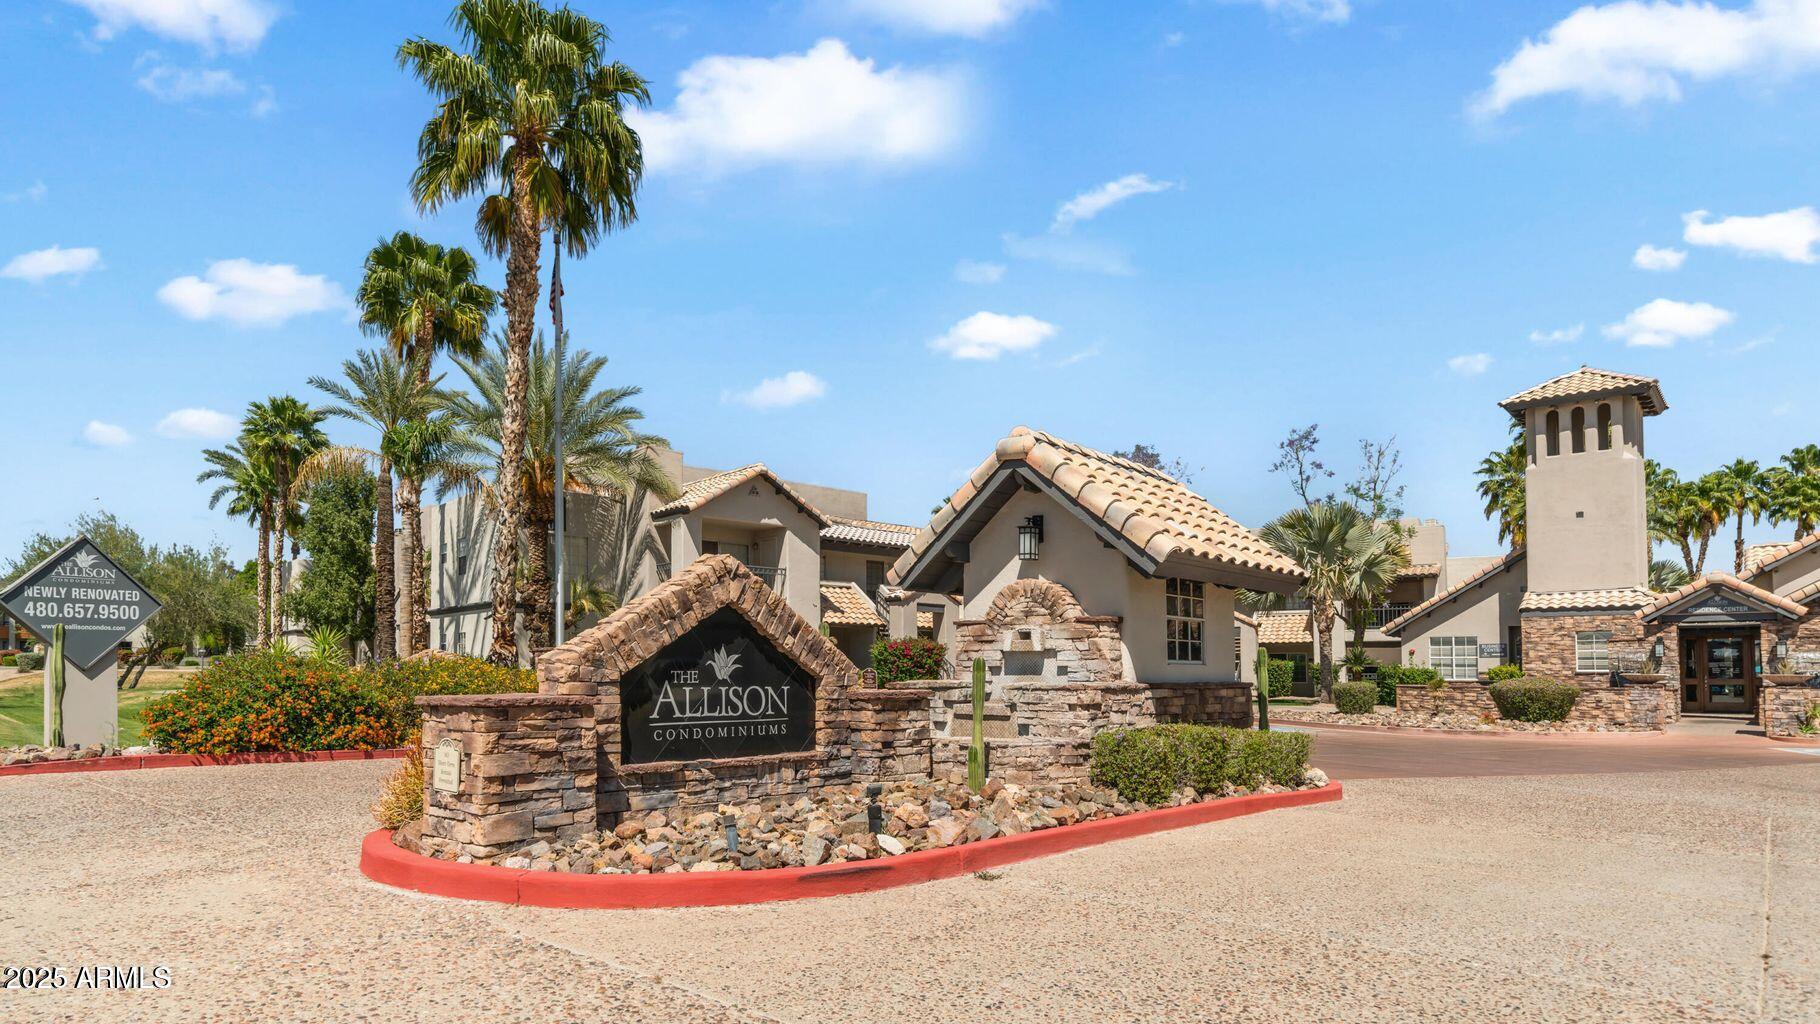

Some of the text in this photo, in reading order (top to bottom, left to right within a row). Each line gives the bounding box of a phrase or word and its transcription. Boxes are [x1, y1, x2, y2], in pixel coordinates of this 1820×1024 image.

[51, 565, 116, 579] ALLISON
[25, 586, 140, 602] NEWLY RENOVATED
[24, 602, 140, 620] 480.657.9500
[671, 670, 700, 684] THE
[649, 680, 790, 719] ALLISON
[653, 724, 787, 741] CONDOMINIUMS
